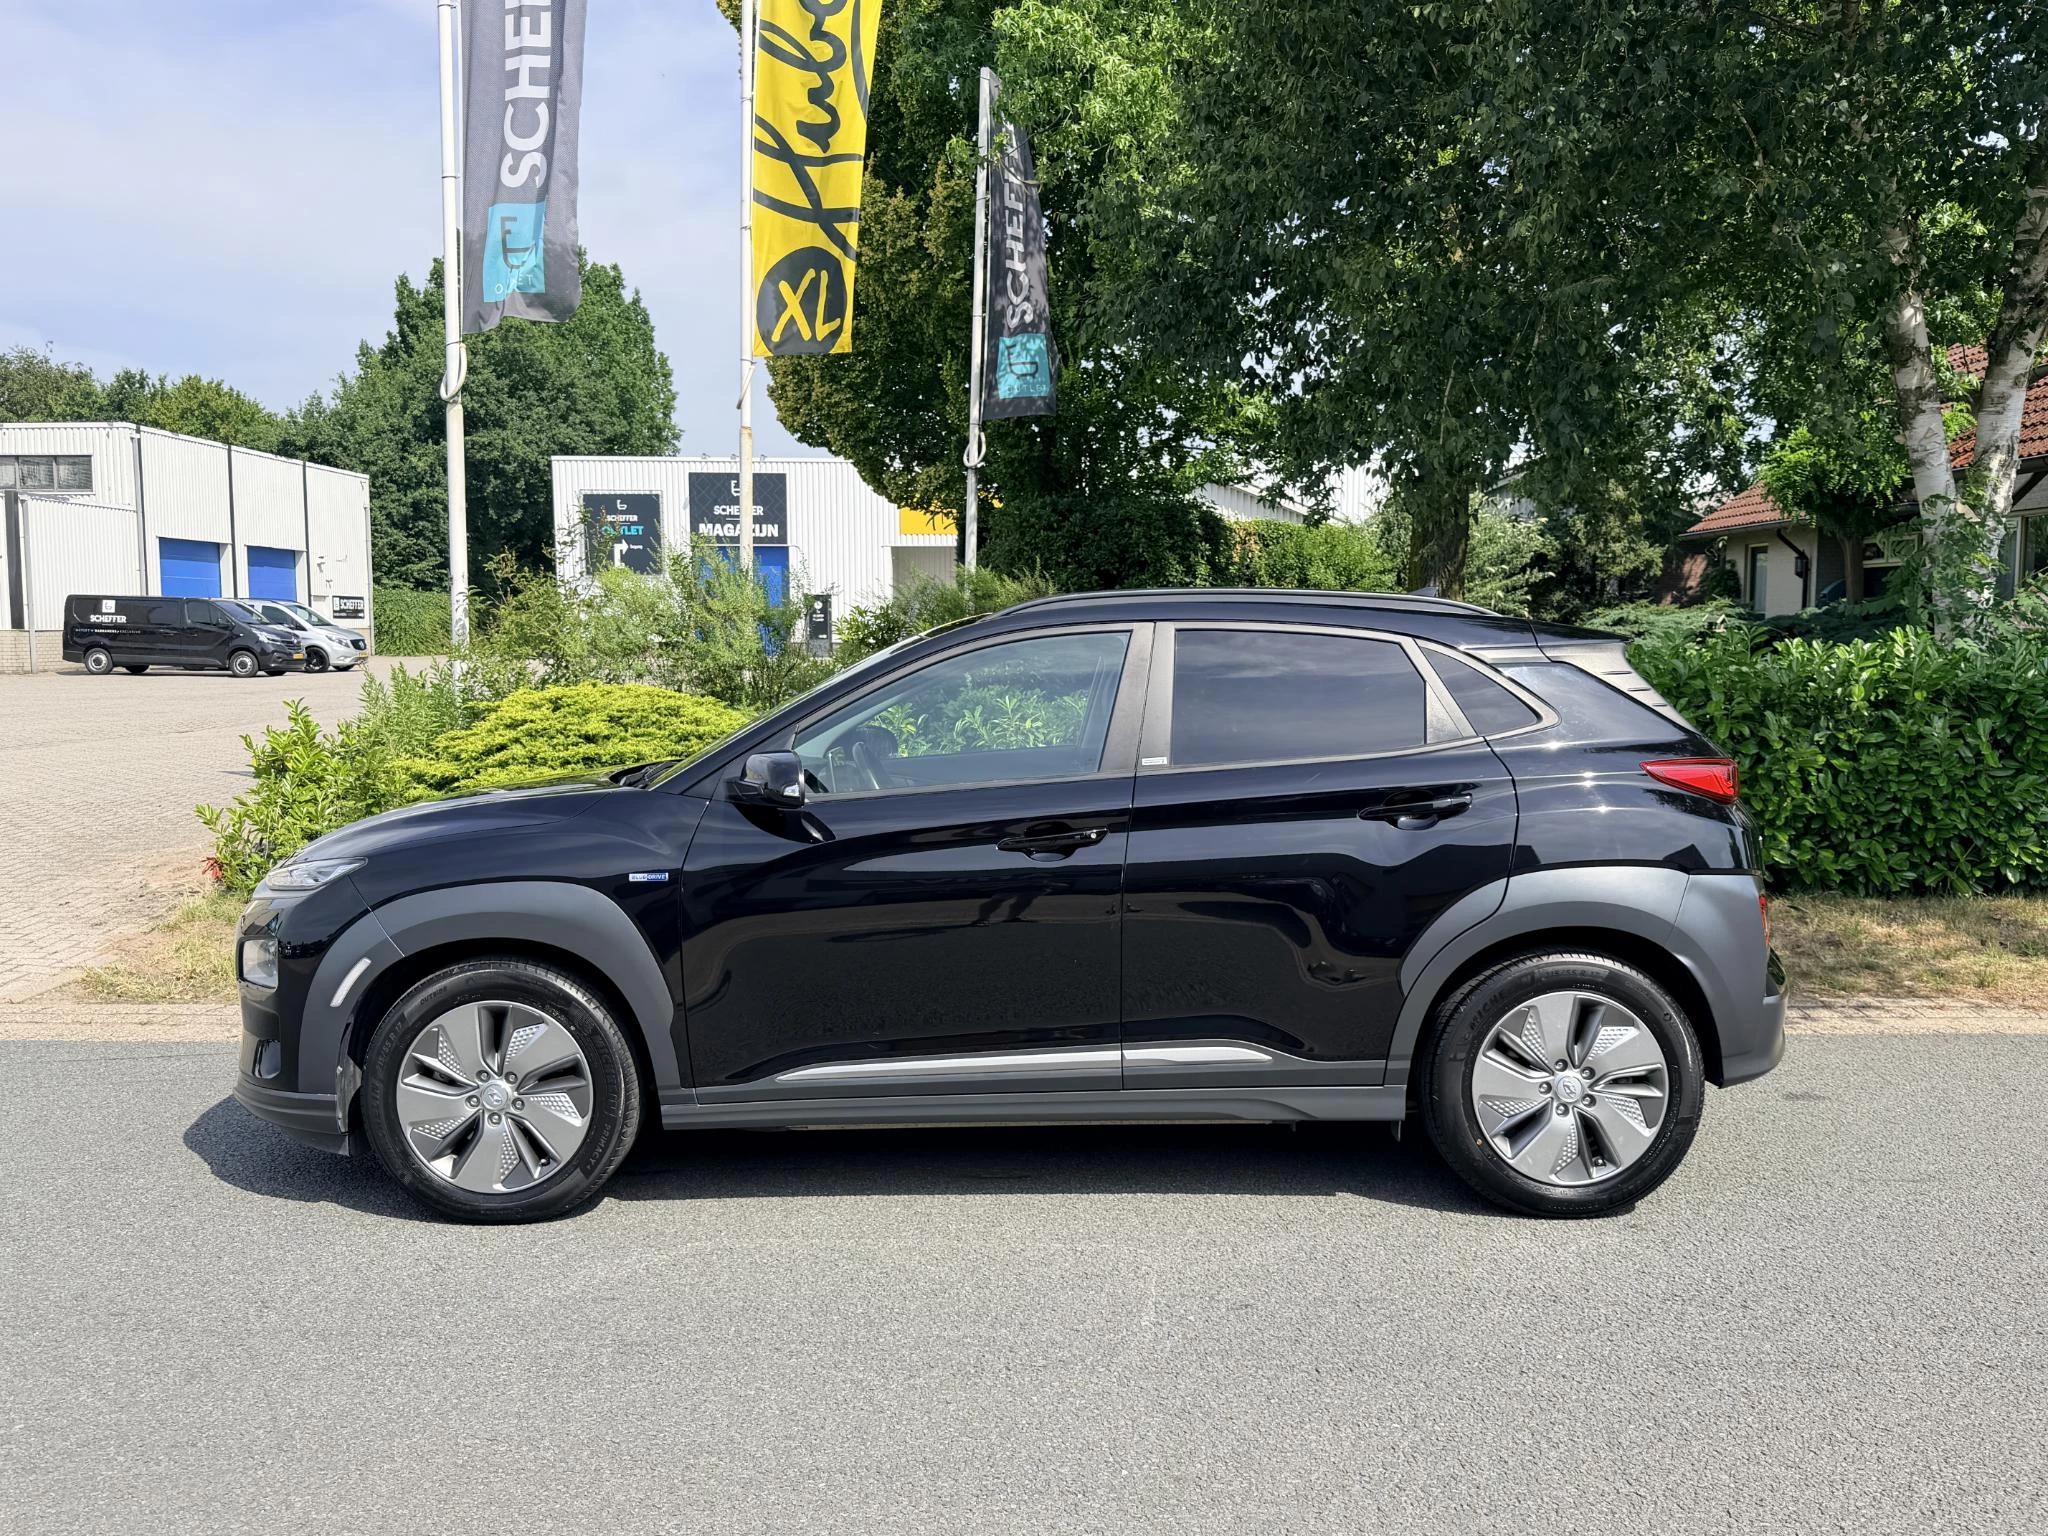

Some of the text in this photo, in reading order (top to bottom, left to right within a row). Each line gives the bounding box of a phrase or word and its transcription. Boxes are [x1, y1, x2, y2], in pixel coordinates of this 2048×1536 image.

[500, 0, 551, 189] SCHE
[1002, 111, 1034, 329] SCHEFF
[771, 268, 841, 342] XL
[601, 525, 644, 535] OTLET
[713, 505, 764, 516] SCHEER
[90, 614, 127, 623] SCHEFFER
